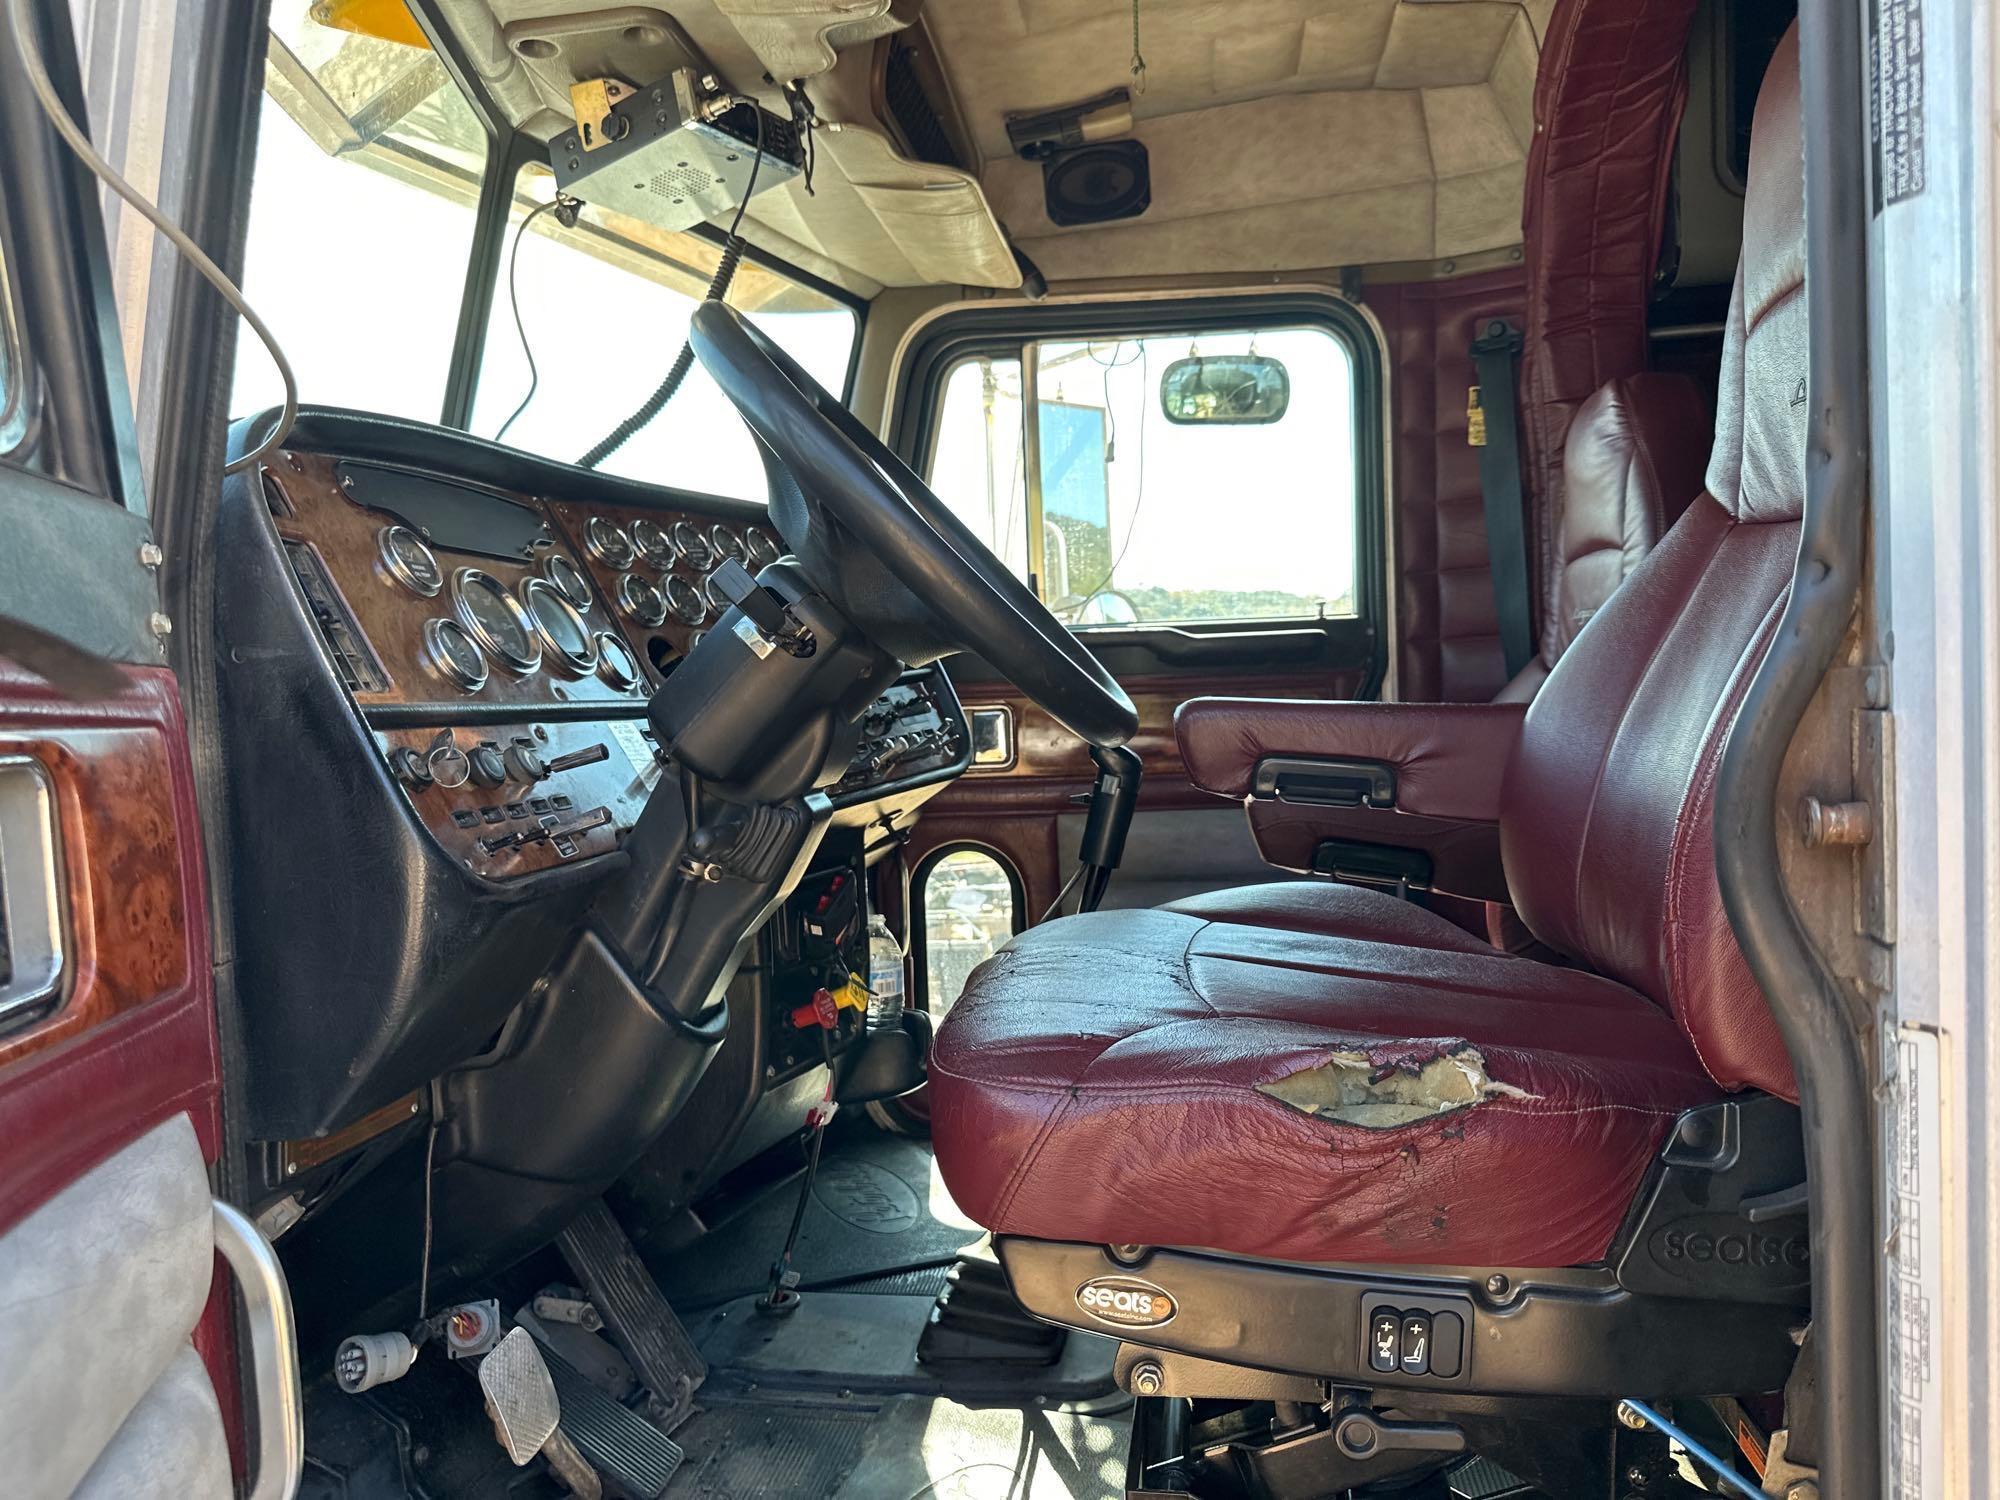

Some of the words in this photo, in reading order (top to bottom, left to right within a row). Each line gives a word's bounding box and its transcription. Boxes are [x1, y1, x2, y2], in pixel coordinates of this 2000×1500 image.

[1871, 33, 1879, 143] CAUTION
[1896, 153, 1909, 197] TRUCK
[1082, 1286, 1152, 1314] seats
